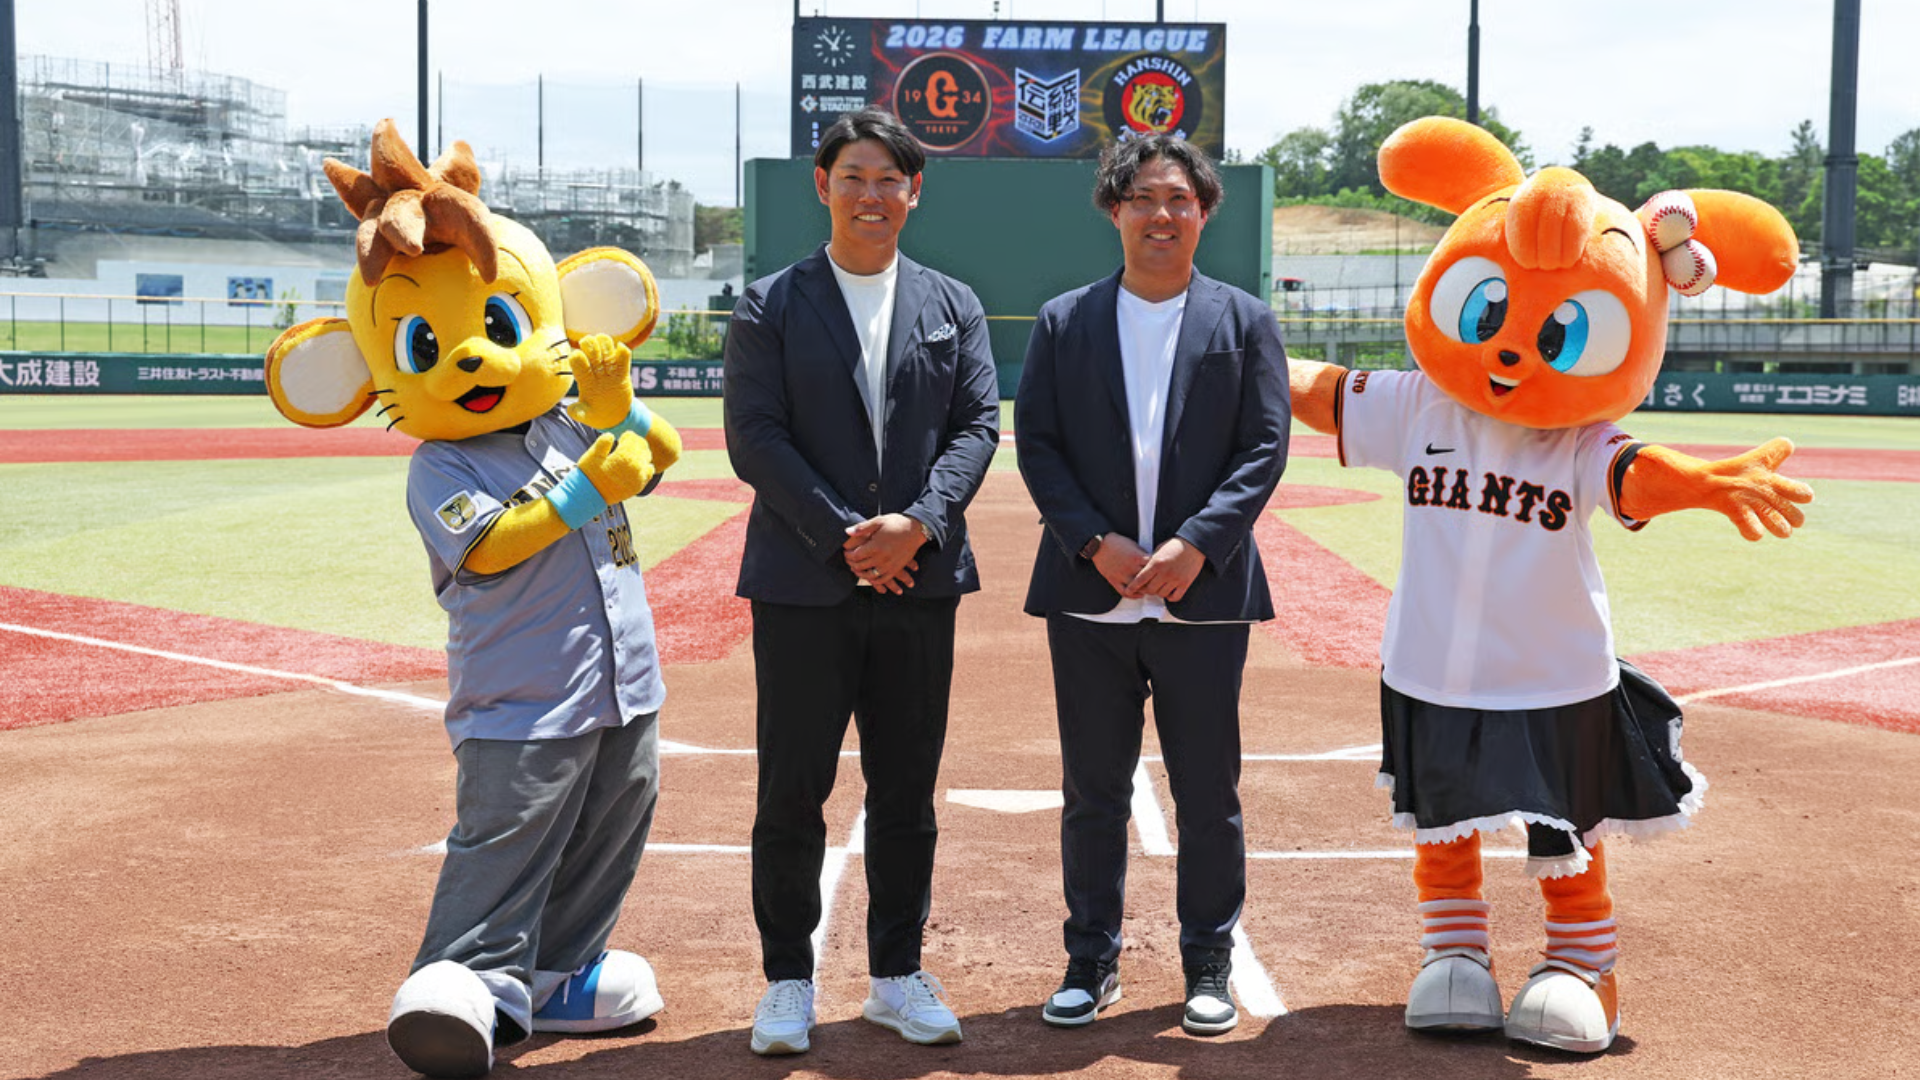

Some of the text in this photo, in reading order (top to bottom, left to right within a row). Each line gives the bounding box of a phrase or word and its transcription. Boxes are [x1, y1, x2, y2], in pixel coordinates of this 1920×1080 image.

[886, 25, 1208, 53] 2026 FARM LEAGUE
[801, 74, 867, 90] 西武建設
[1113, 57, 1192, 87] HANSHIN
[904, 70, 981, 118] 19 G 34
[925, 125, 959, 133] TOKYO
[1776, 385, 1867, 405] エコミナミ
[1408, 465, 1573, 532] GIANTS
